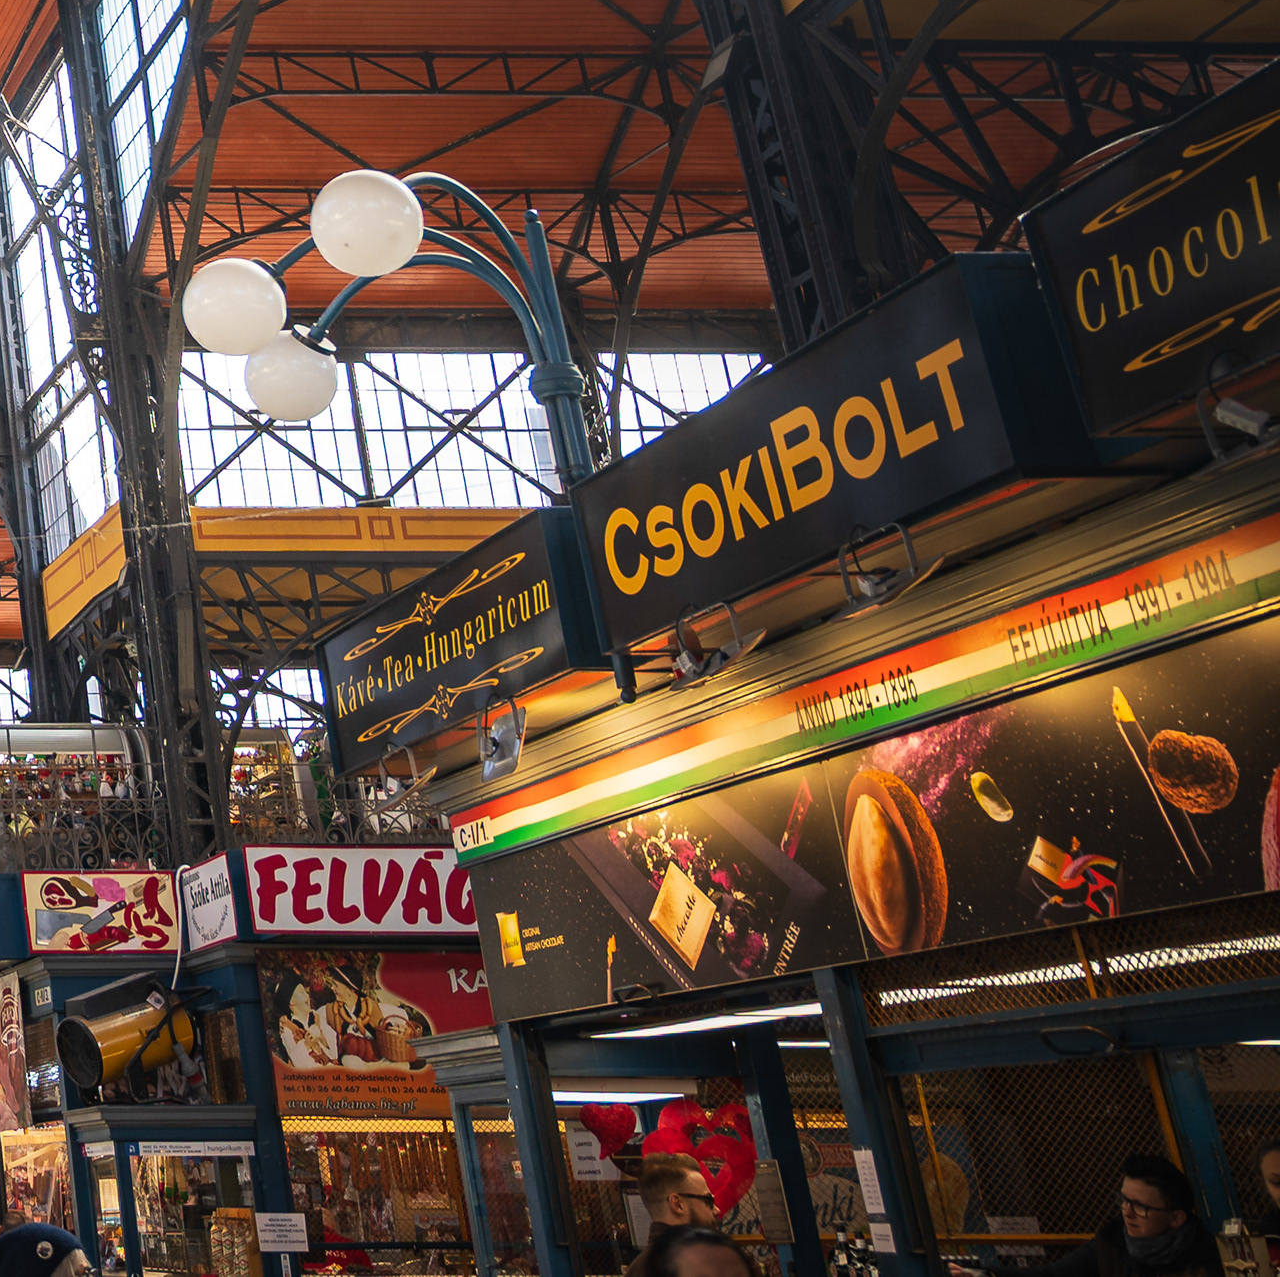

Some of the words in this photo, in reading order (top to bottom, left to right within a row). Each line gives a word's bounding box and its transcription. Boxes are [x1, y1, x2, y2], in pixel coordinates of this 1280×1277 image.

[1076, 175, 1280, 332] Chocol
[1007, 596, 1114, 670] FELÚJÍTVA
[794, 690, 837, 739] ANNO
[210, 872, 231, 901] Attila
[333, 1073, 342, 1082] ul.
[344, 1086, 360, 1094] 467
[286, 1097, 417, 1114] www.kabanos.biz.pl
